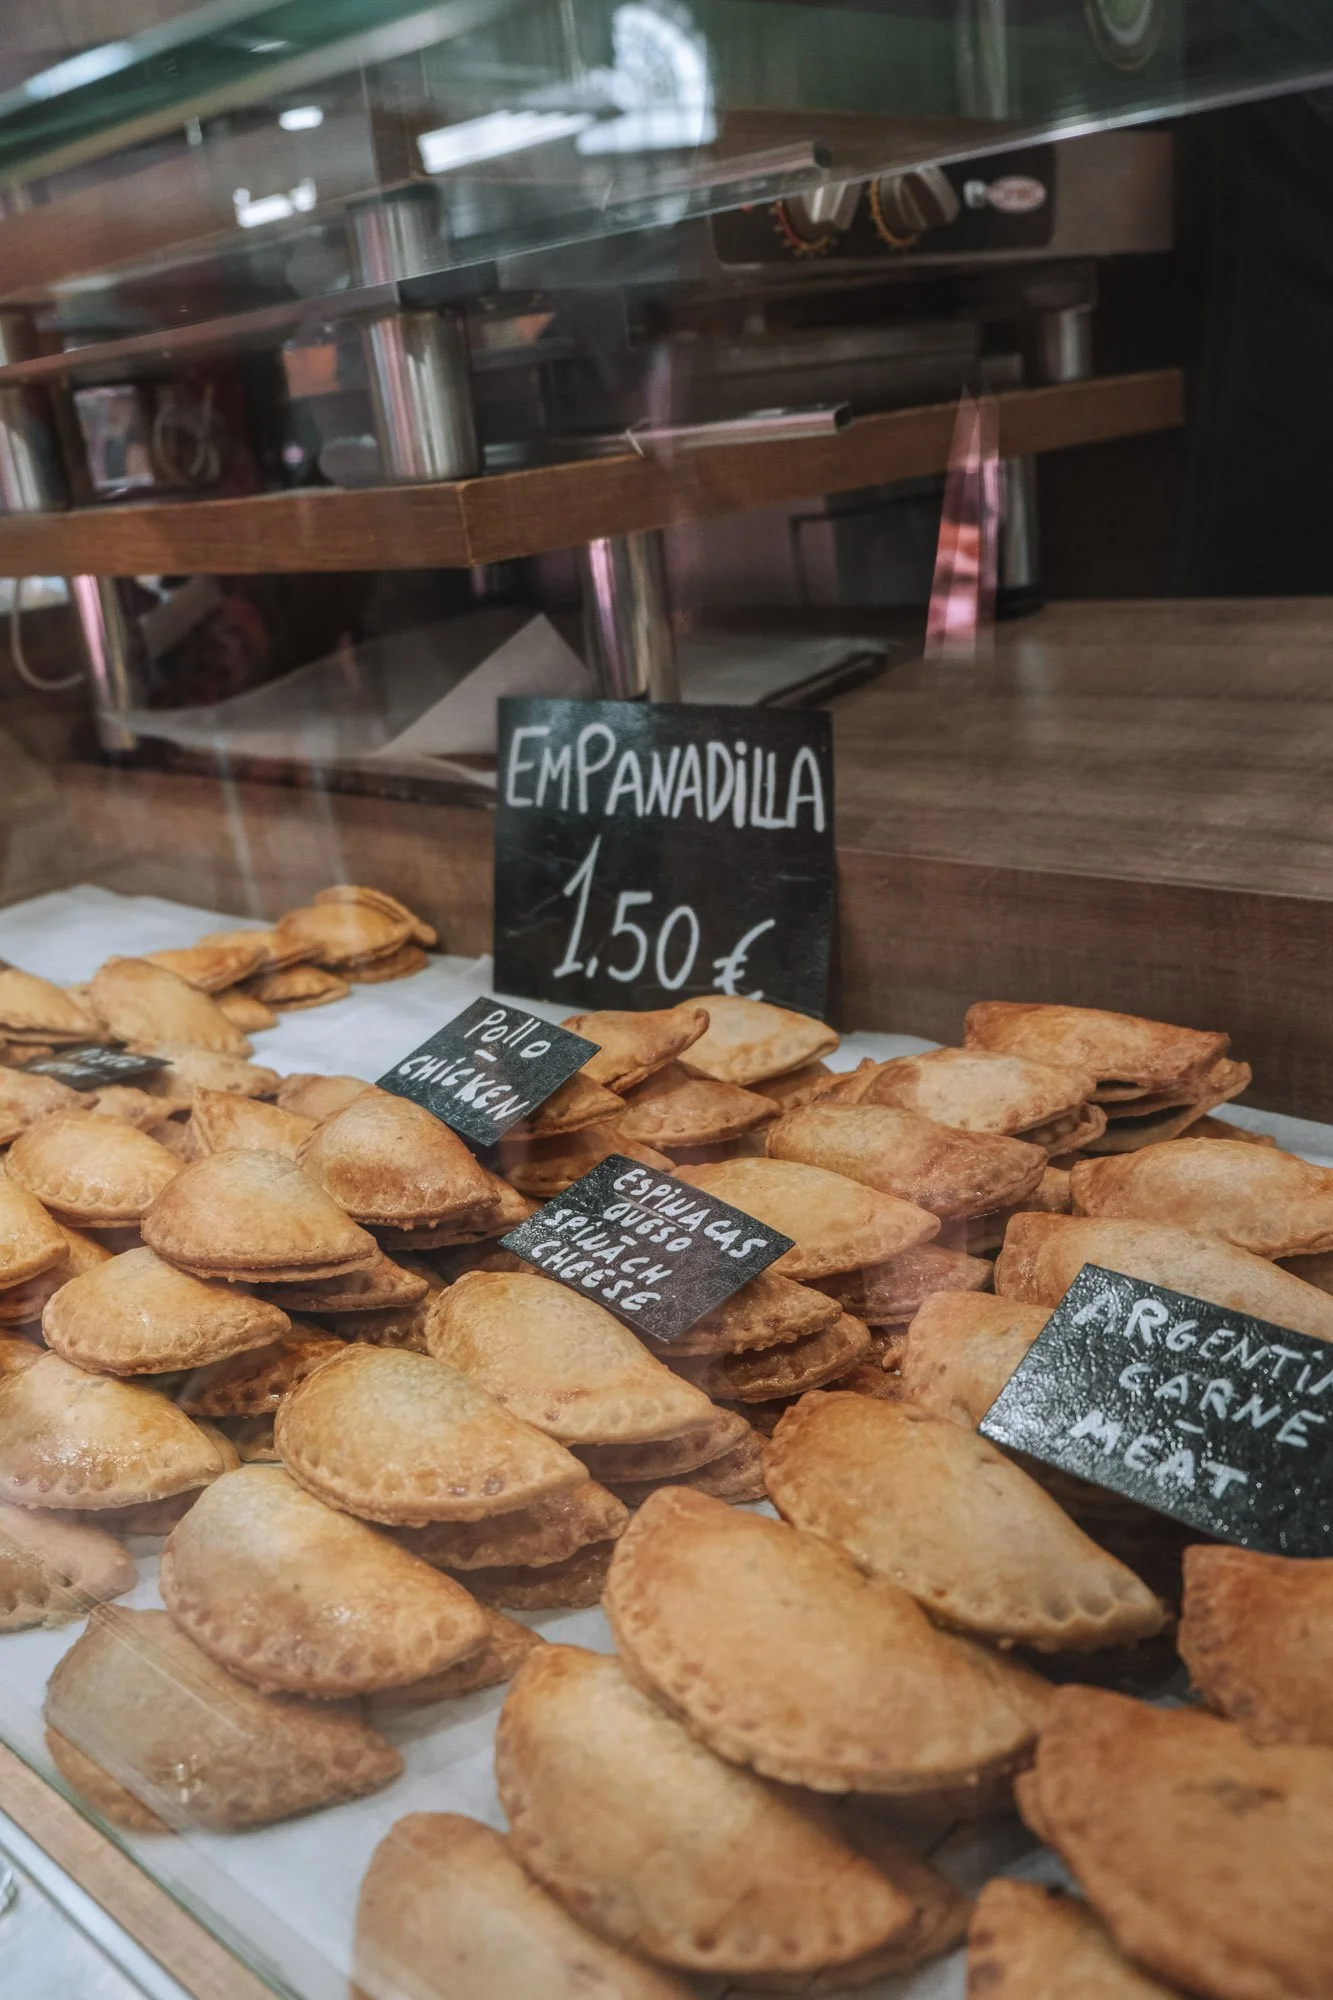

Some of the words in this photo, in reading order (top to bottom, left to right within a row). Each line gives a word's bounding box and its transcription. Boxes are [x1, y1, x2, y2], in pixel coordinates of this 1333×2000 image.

[713, 919, 776, 1001] €
[463, 1009, 552, 1059] Pollo
[1118, 1362, 1326, 1448] CARNE
[1069, 1410, 1249, 1500] MEAT
